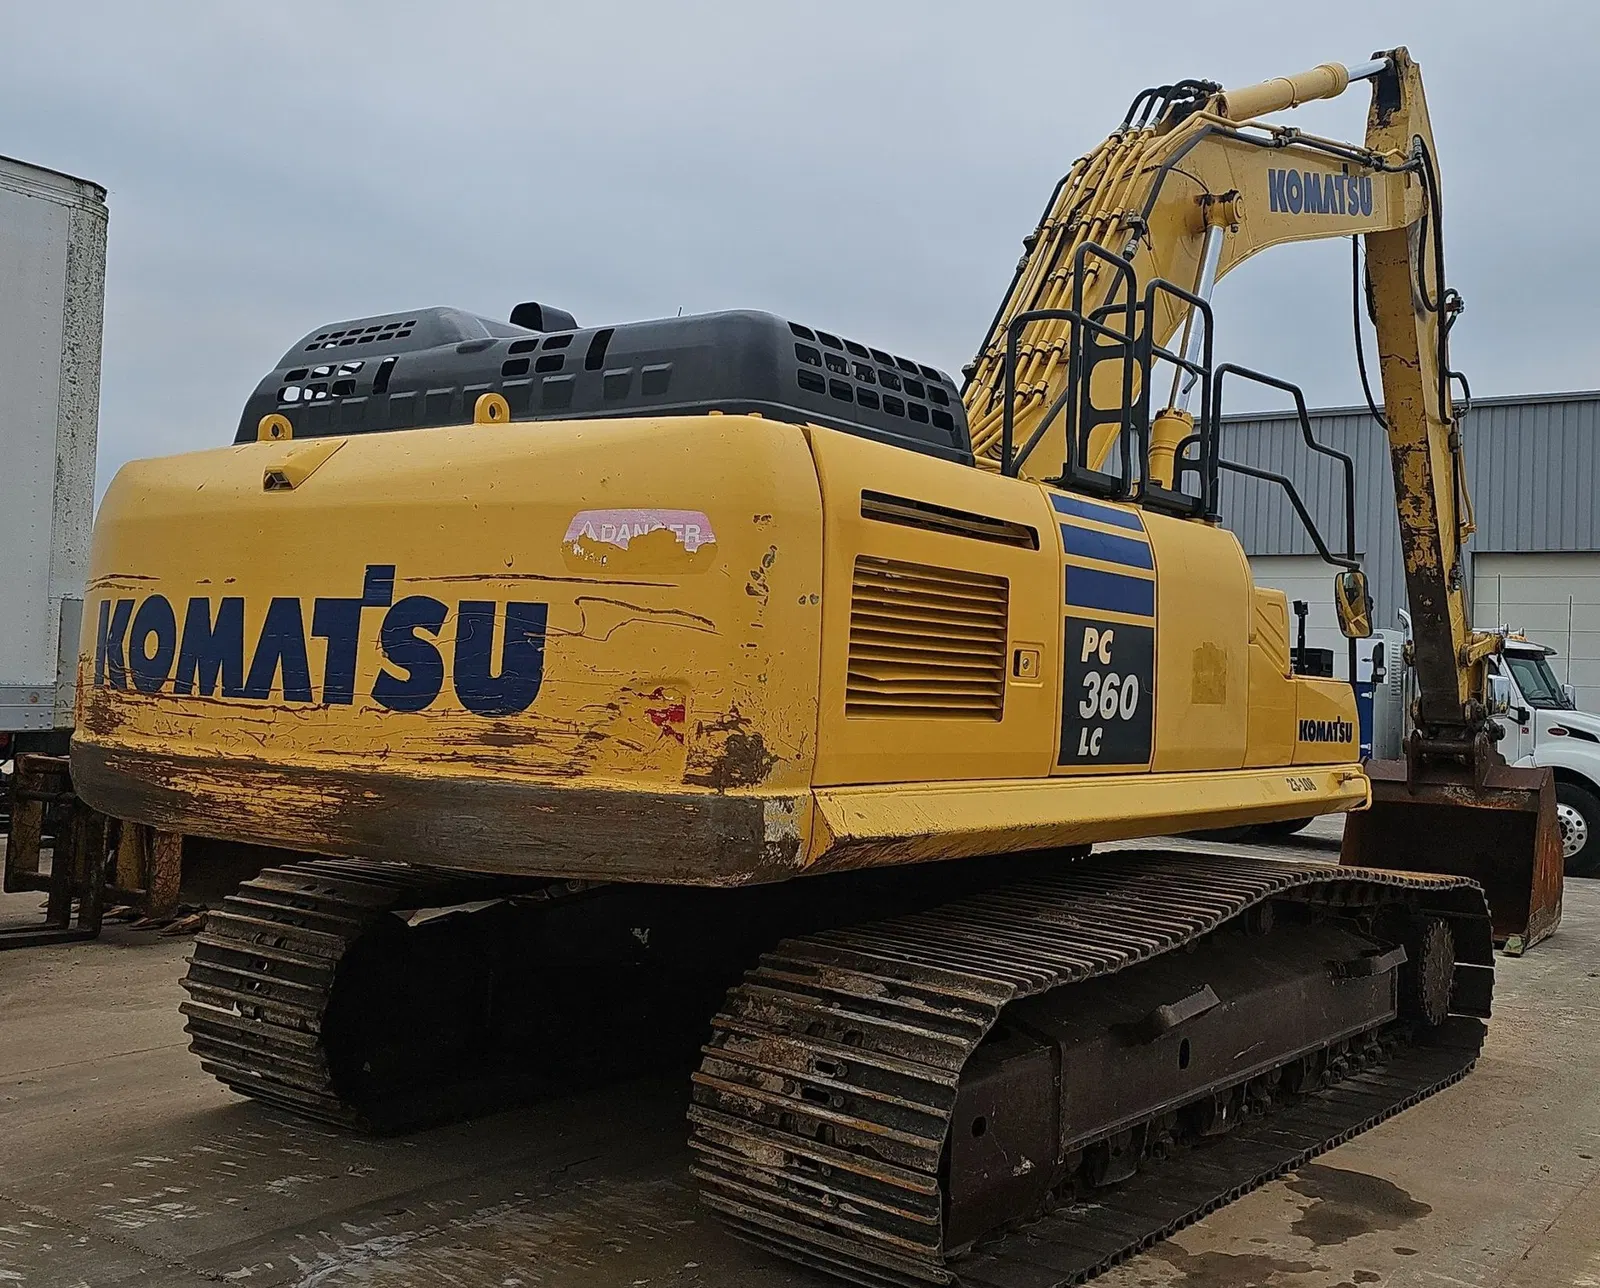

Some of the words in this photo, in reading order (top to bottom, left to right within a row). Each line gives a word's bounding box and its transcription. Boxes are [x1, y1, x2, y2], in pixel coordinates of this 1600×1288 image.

[1269, 164, 1373, 216] KOMATSU
[96, 564, 548, 716] KOMATSU
[1081, 627, 1114, 665] PC
[1079, 671, 1139, 721] 360
[1077, 727, 1103, 756] LC
[1298, 715, 1353, 743] KOMATSU
